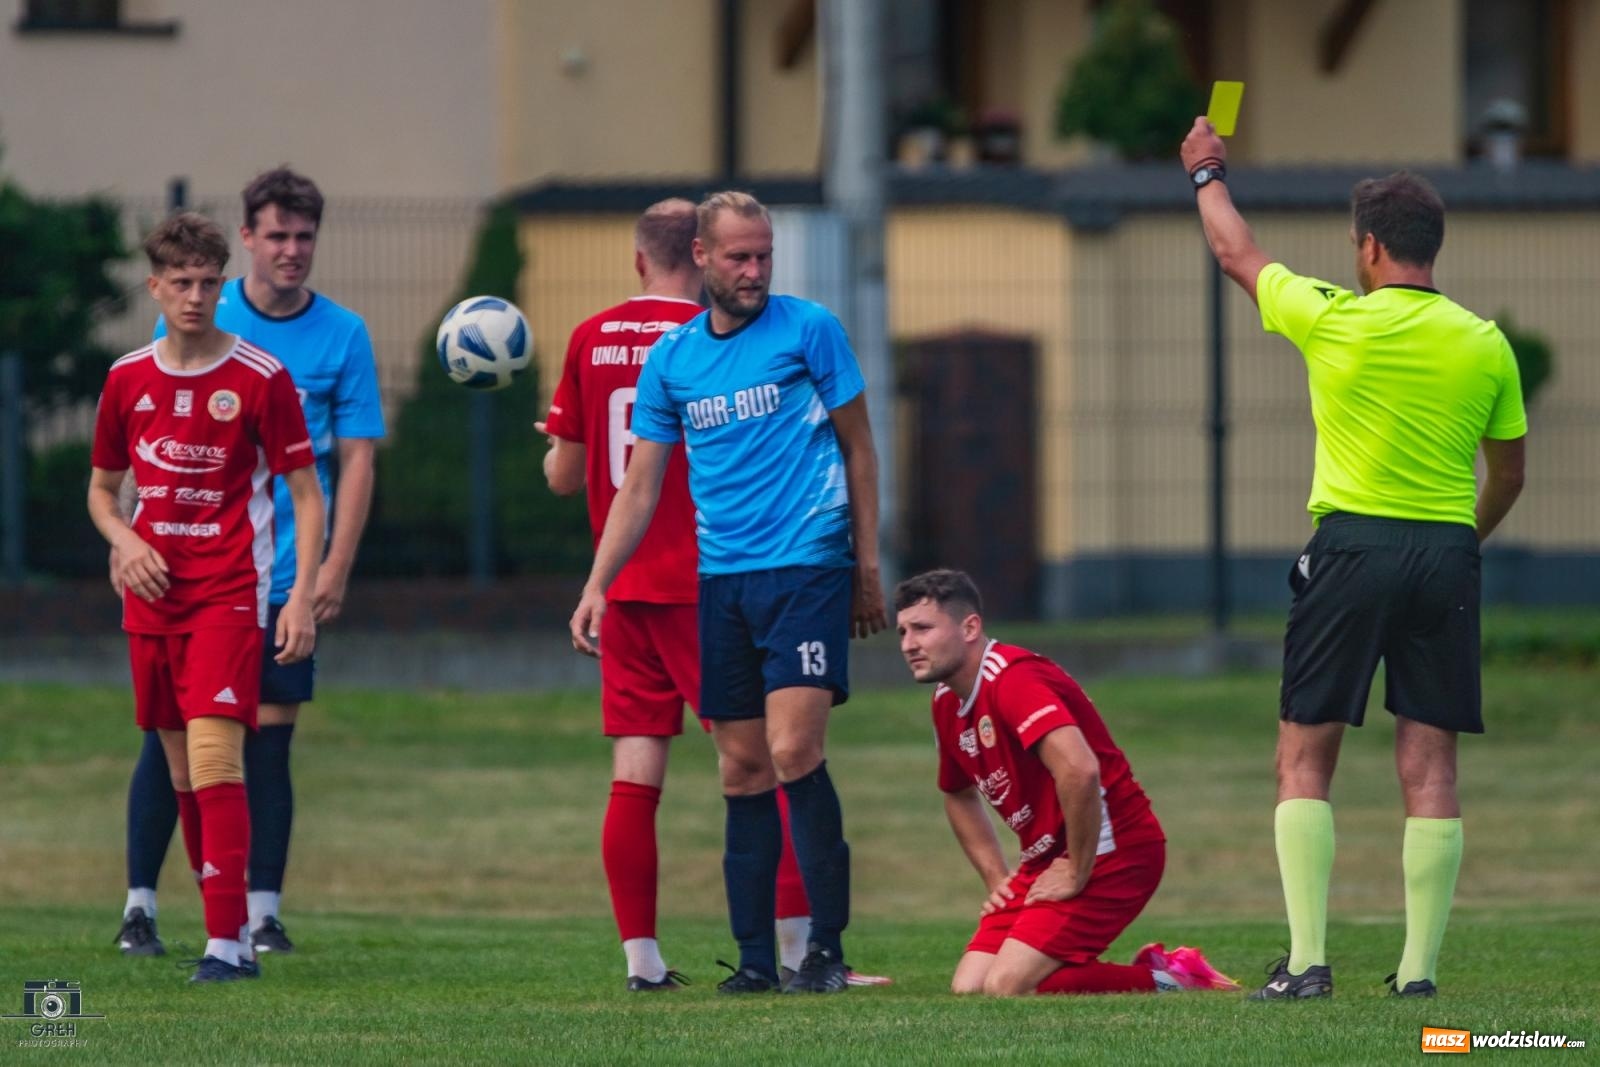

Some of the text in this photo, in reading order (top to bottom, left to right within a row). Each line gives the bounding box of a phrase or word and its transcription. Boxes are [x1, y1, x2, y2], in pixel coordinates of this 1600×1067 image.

[592, 345, 650, 366] UNIA TU
[686, 383, 780, 430] DAR-BUD
[797, 641, 826, 676] 13
